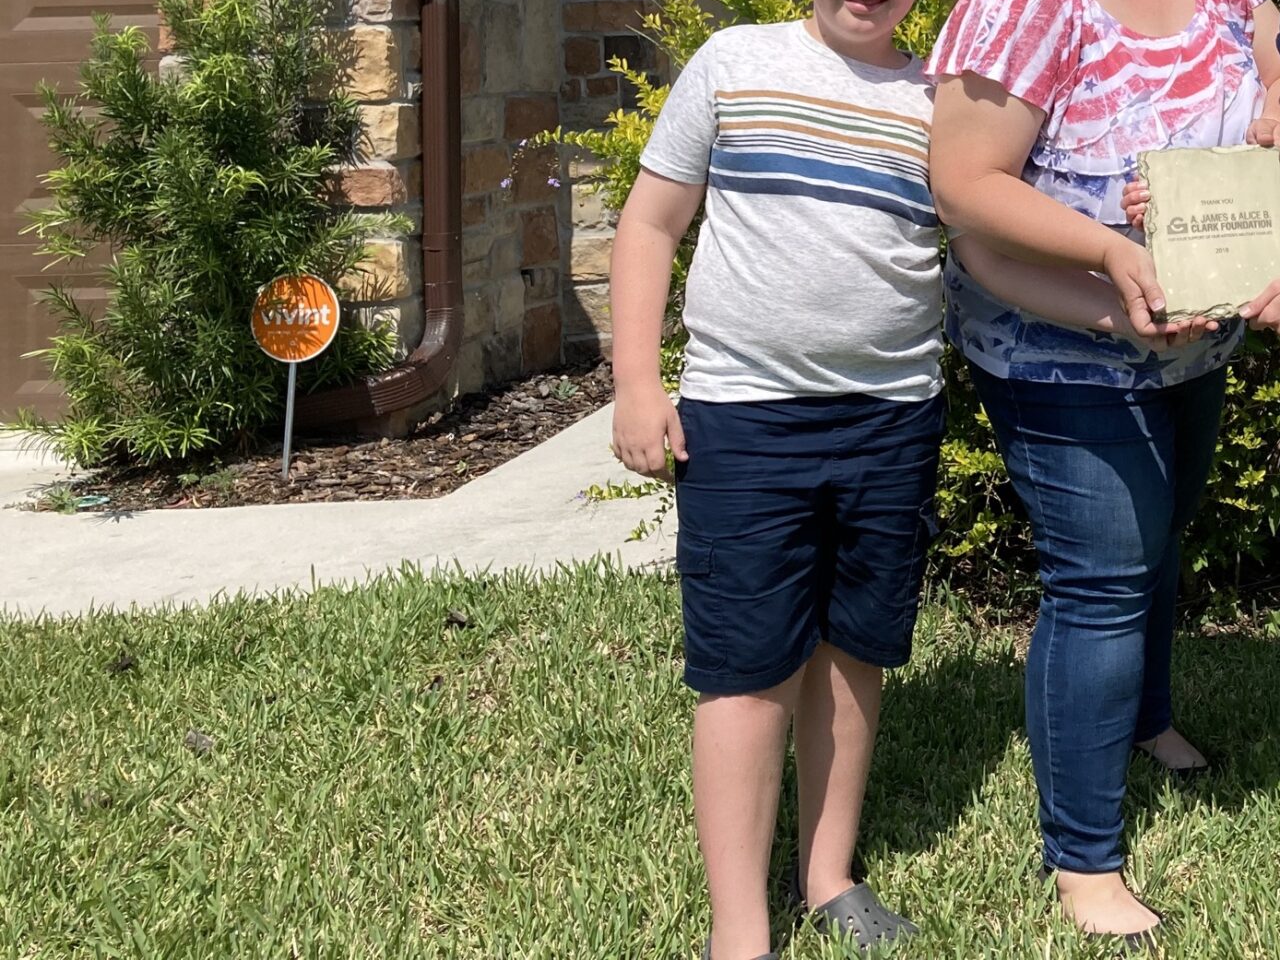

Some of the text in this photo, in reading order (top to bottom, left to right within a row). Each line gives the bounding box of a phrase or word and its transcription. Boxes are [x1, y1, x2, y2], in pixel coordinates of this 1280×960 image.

[1190, 215, 1200, 224] A.
[1201, 213, 1229, 223] JAMES
[1230, 213, 1238, 221] &
[1238, 211, 1261, 220] ALICE
[1191, 220, 1273, 233] CLARK FOUNDATION
[261, 303, 331, 326] vivint
